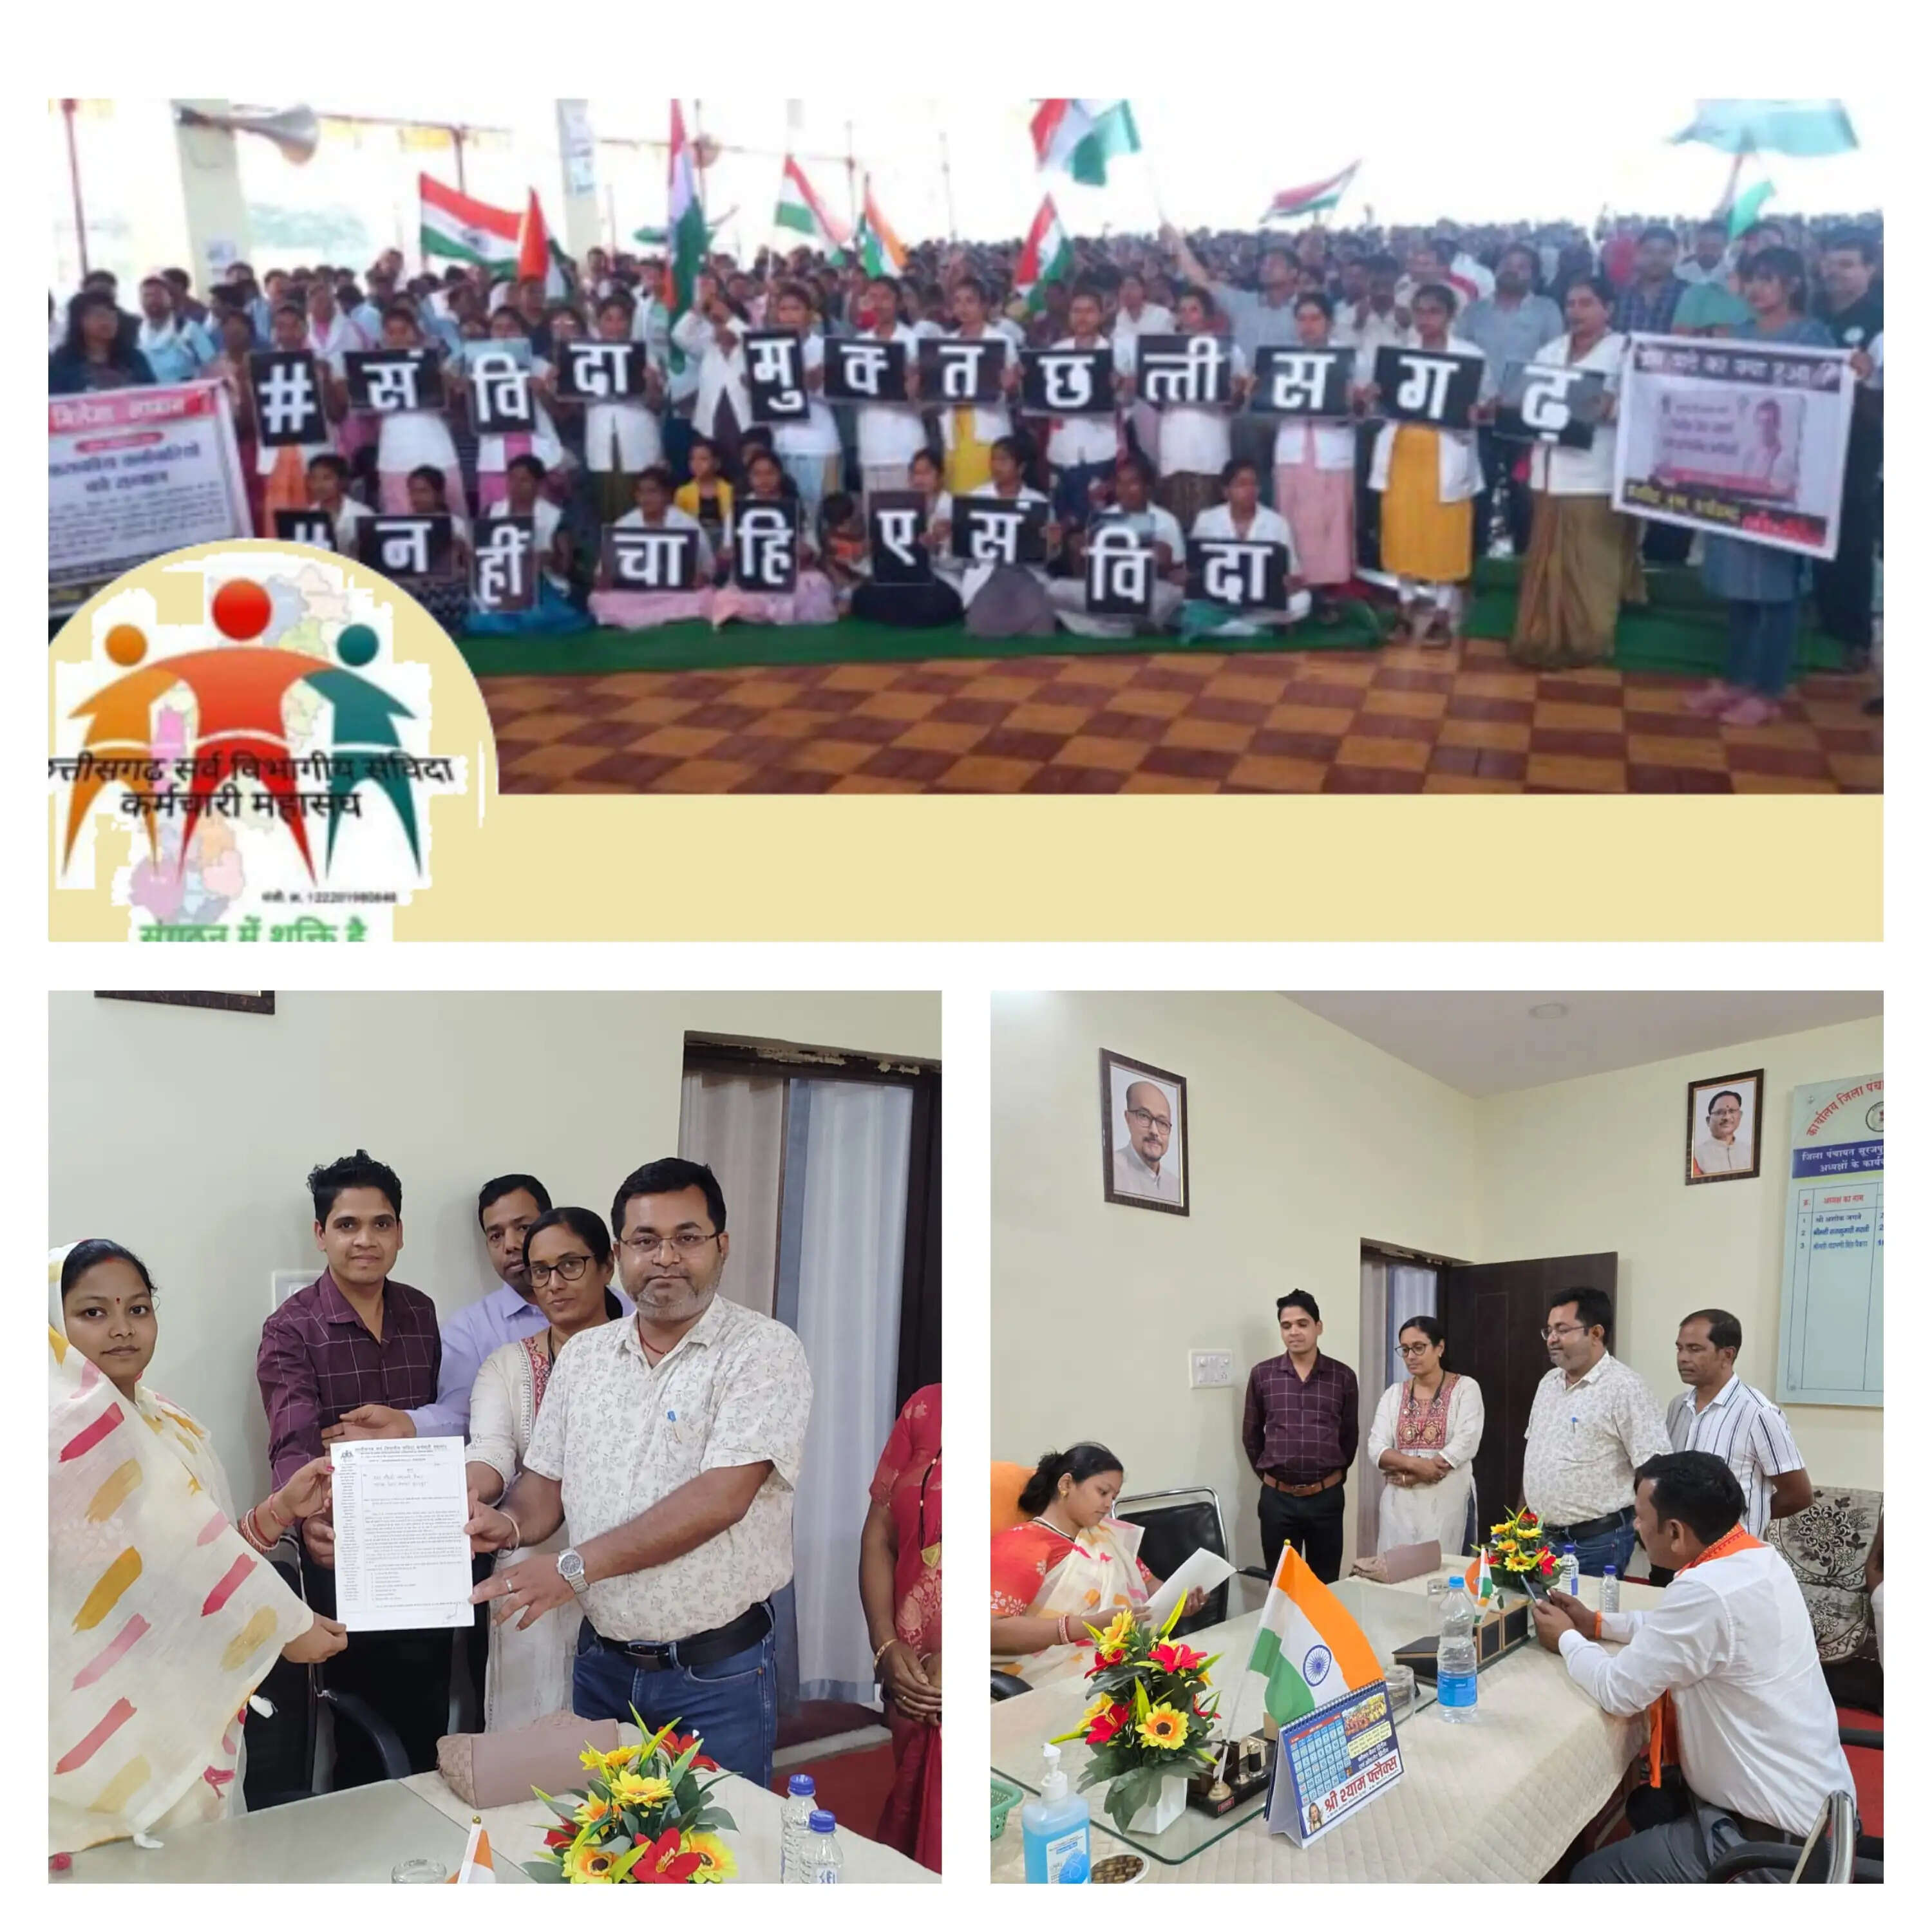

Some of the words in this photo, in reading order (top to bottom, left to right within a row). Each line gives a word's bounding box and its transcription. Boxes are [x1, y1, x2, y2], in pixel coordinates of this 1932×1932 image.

[1806, 1101, 1839, 1137] कार्यालय
[1837, 1086, 1863, 1104] जिला
[1802, 1151, 1823, 1161] जिला
[1324, 1788, 1339, 1812] श्री
